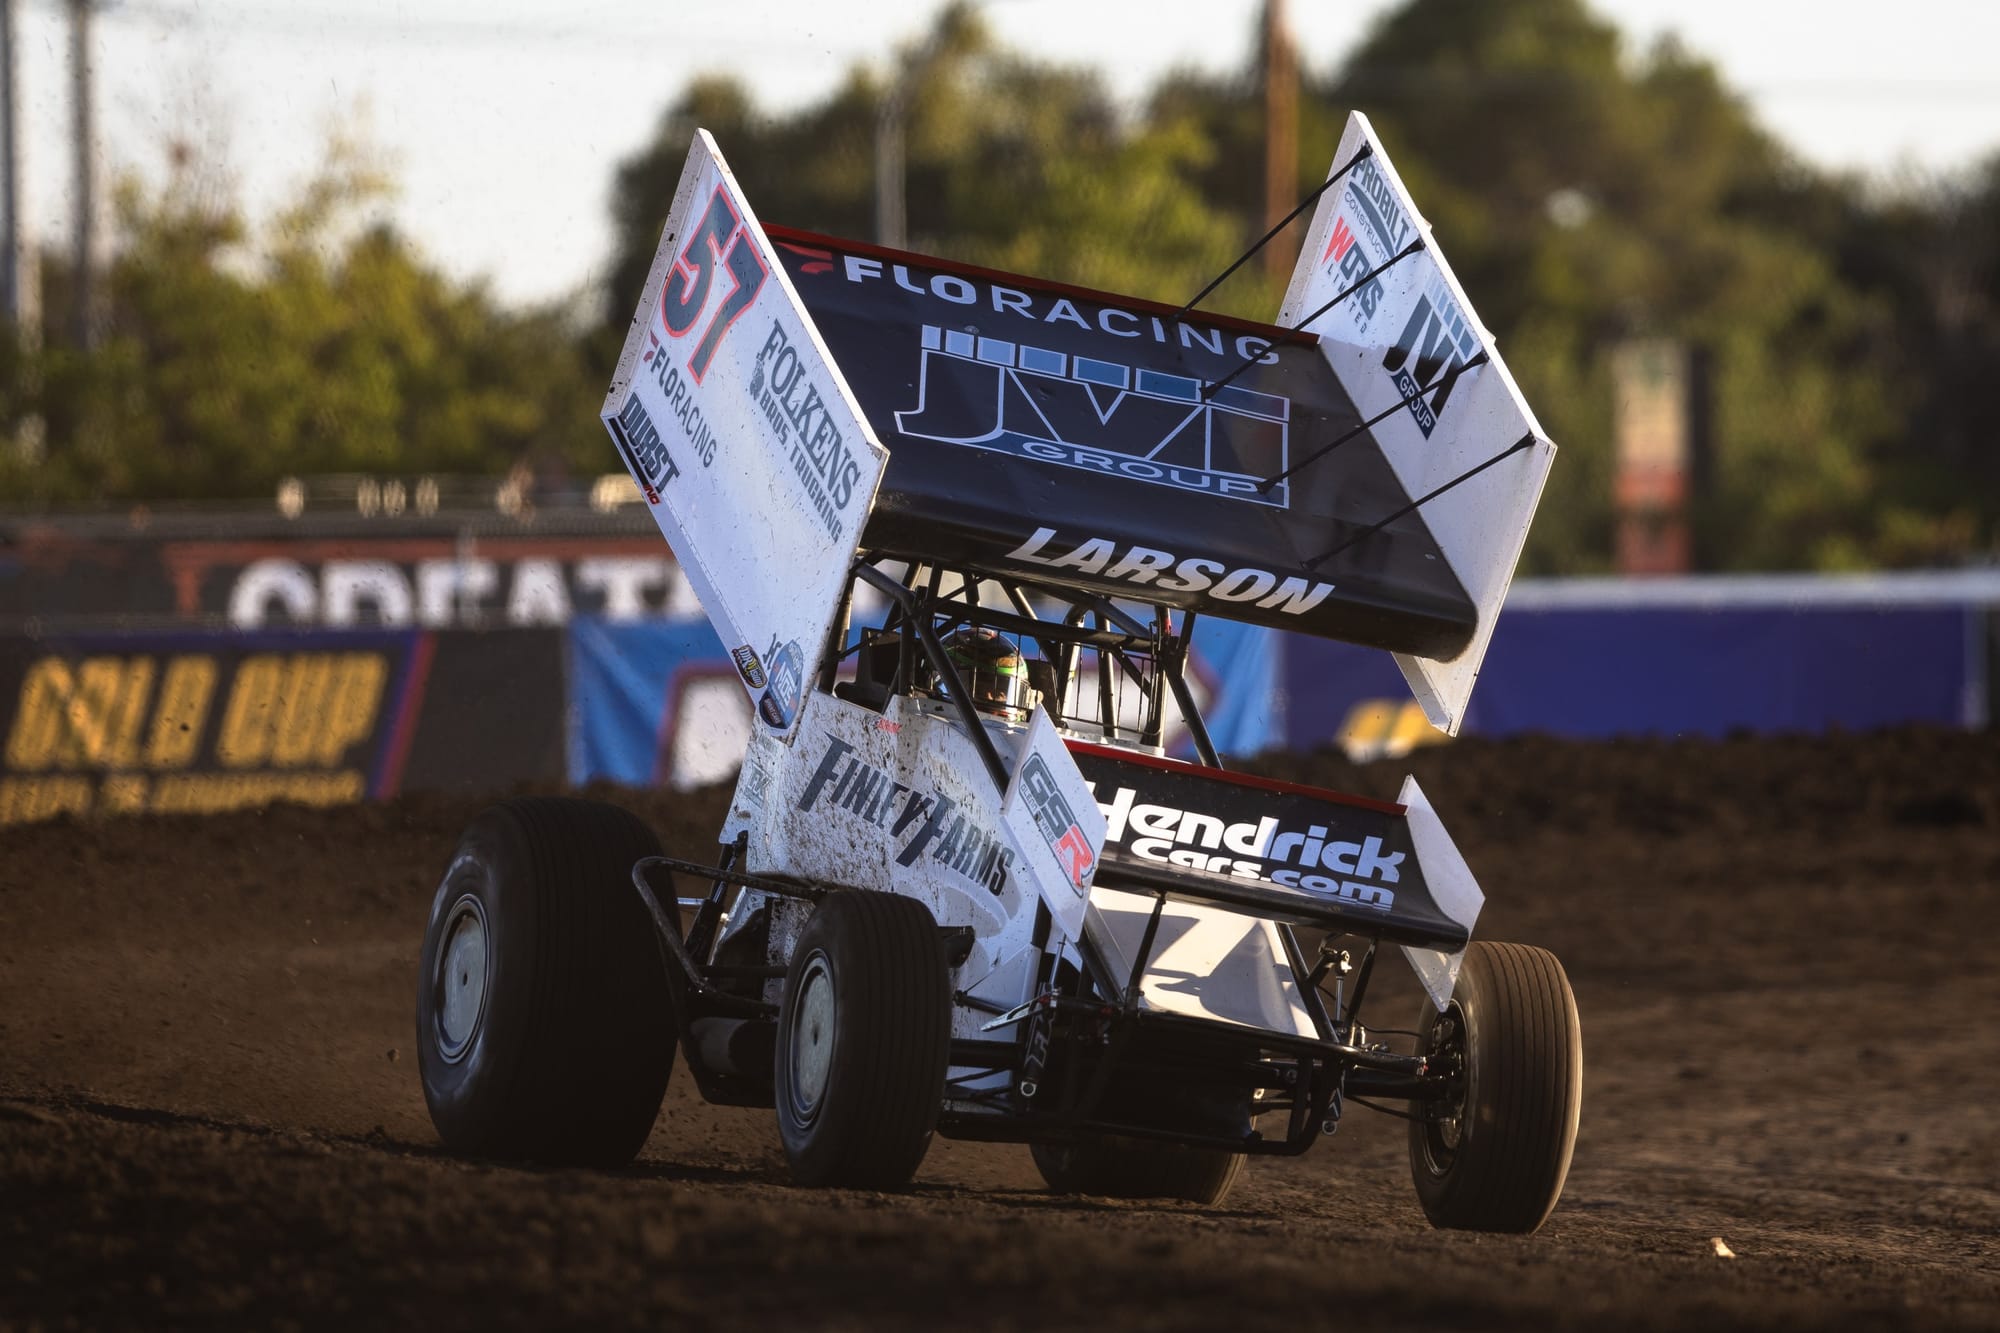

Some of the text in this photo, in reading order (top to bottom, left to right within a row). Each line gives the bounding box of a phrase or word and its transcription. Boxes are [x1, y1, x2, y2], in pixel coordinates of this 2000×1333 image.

[1351, 159, 1409, 253] PROBILT
[661, 183, 770, 385] 57
[844, 256, 1280, 365] FLORACING
[617, 391, 681, 494] DURST
[651, 345, 717, 468] FLORACING
[759, 318, 861, 510] FOLKENS
[1400, 374, 1434, 430] GROUP
[759, 387, 843, 543] BROS. TRUCKING
[1022, 441, 1258, 493] GROUP
[1006, 528, 1335, 615] LARSON
[799, 732, 934, 838] FINLEY
[895, 790, 1015, 896] FARMS
[1022, 757, 1093, 889] GSR
